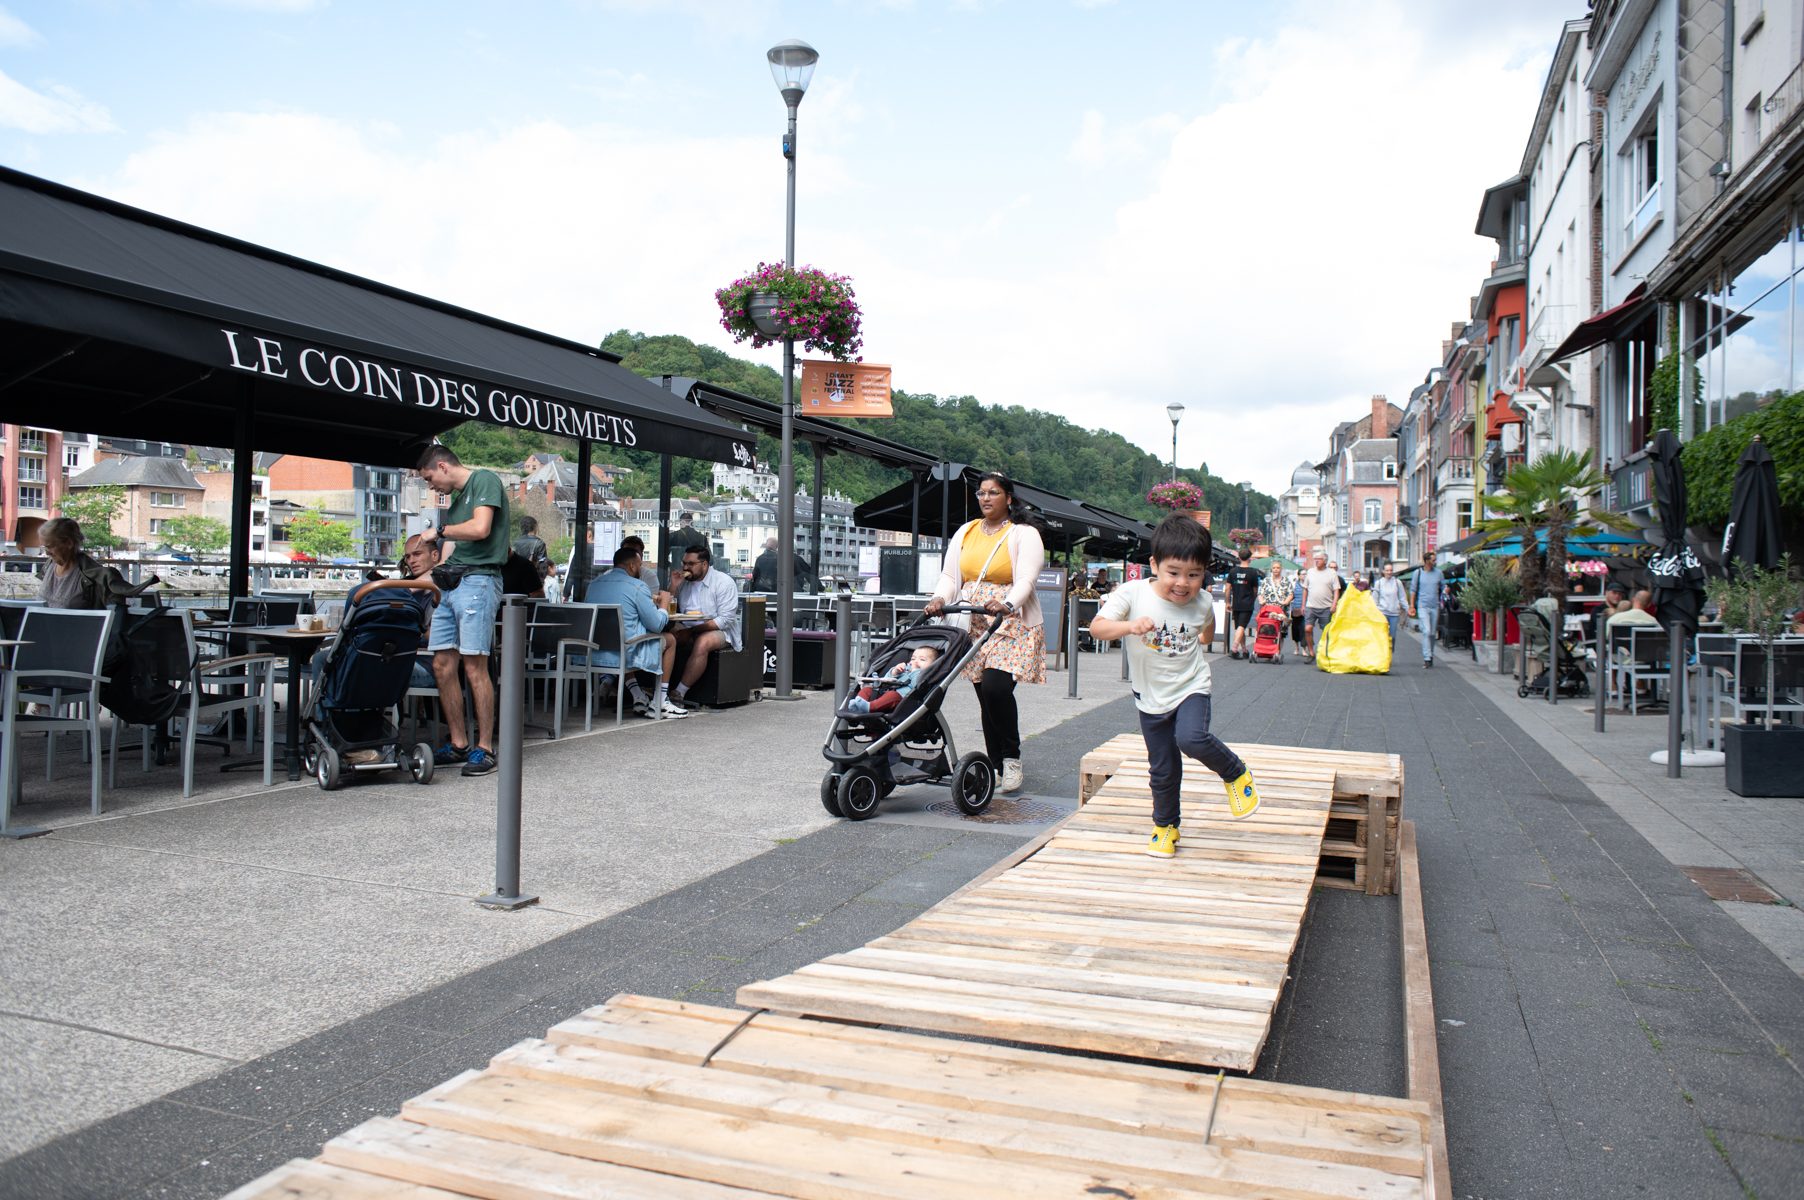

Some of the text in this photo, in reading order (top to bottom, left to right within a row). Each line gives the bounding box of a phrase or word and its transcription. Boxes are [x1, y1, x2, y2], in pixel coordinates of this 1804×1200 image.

[221, 329, 637, 447] LE COIN DES GOURMETS
